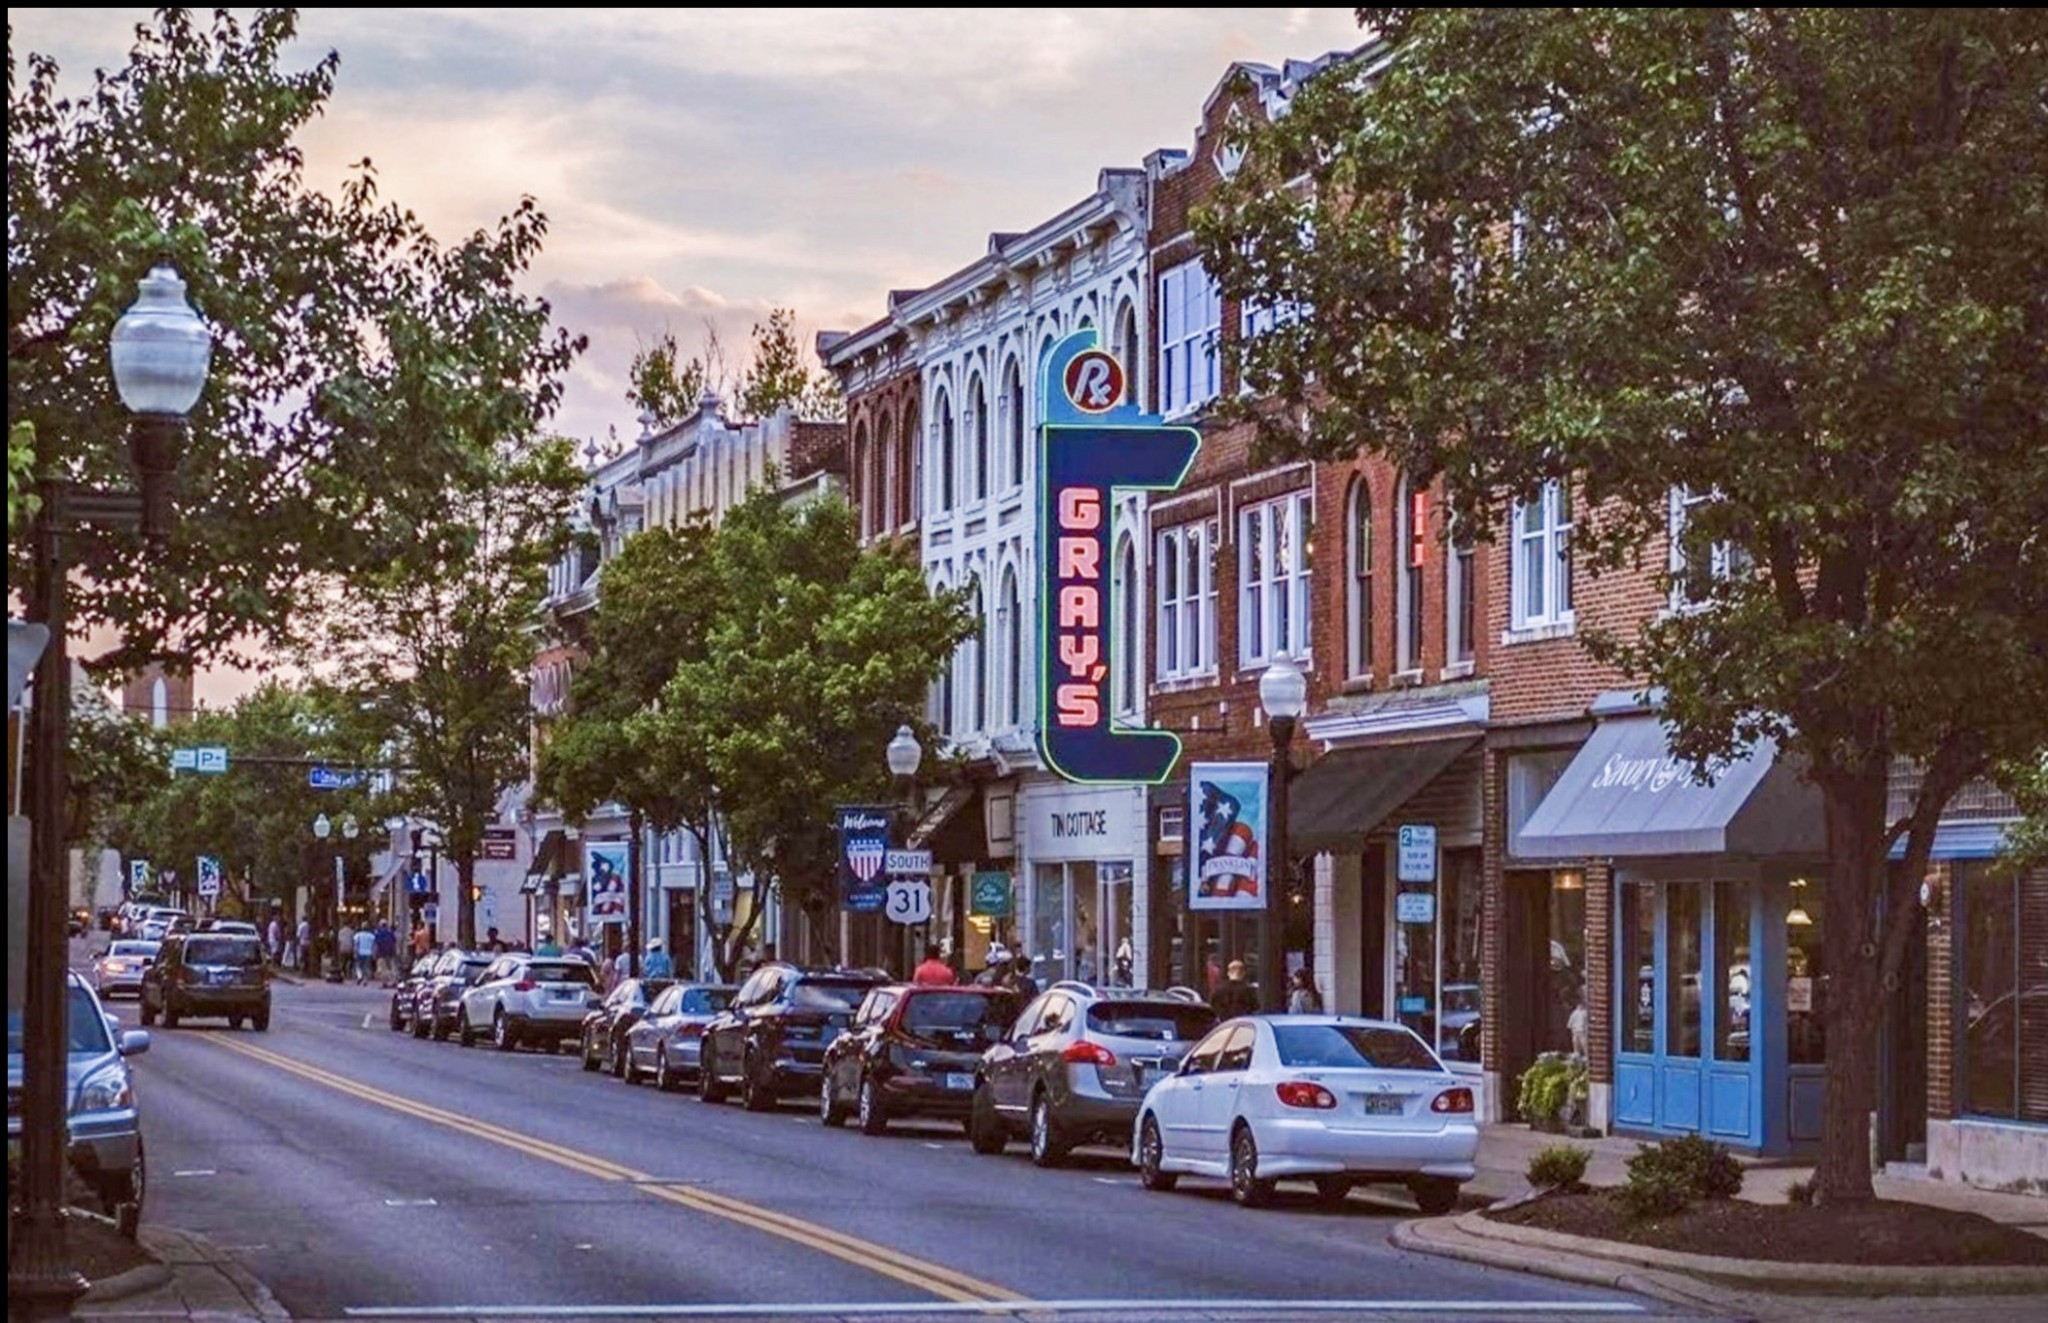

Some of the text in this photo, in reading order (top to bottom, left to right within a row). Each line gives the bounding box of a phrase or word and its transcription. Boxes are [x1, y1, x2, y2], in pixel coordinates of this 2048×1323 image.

[1057, 487, 1106, 726] GRAY'S
[844, 813, 886, 830] Welcome
[1051, 809, 1107, 837] TIN COTTAGE
[888, 855, 928, 868] SOUTH
[895, 889, 920, 913] 31
